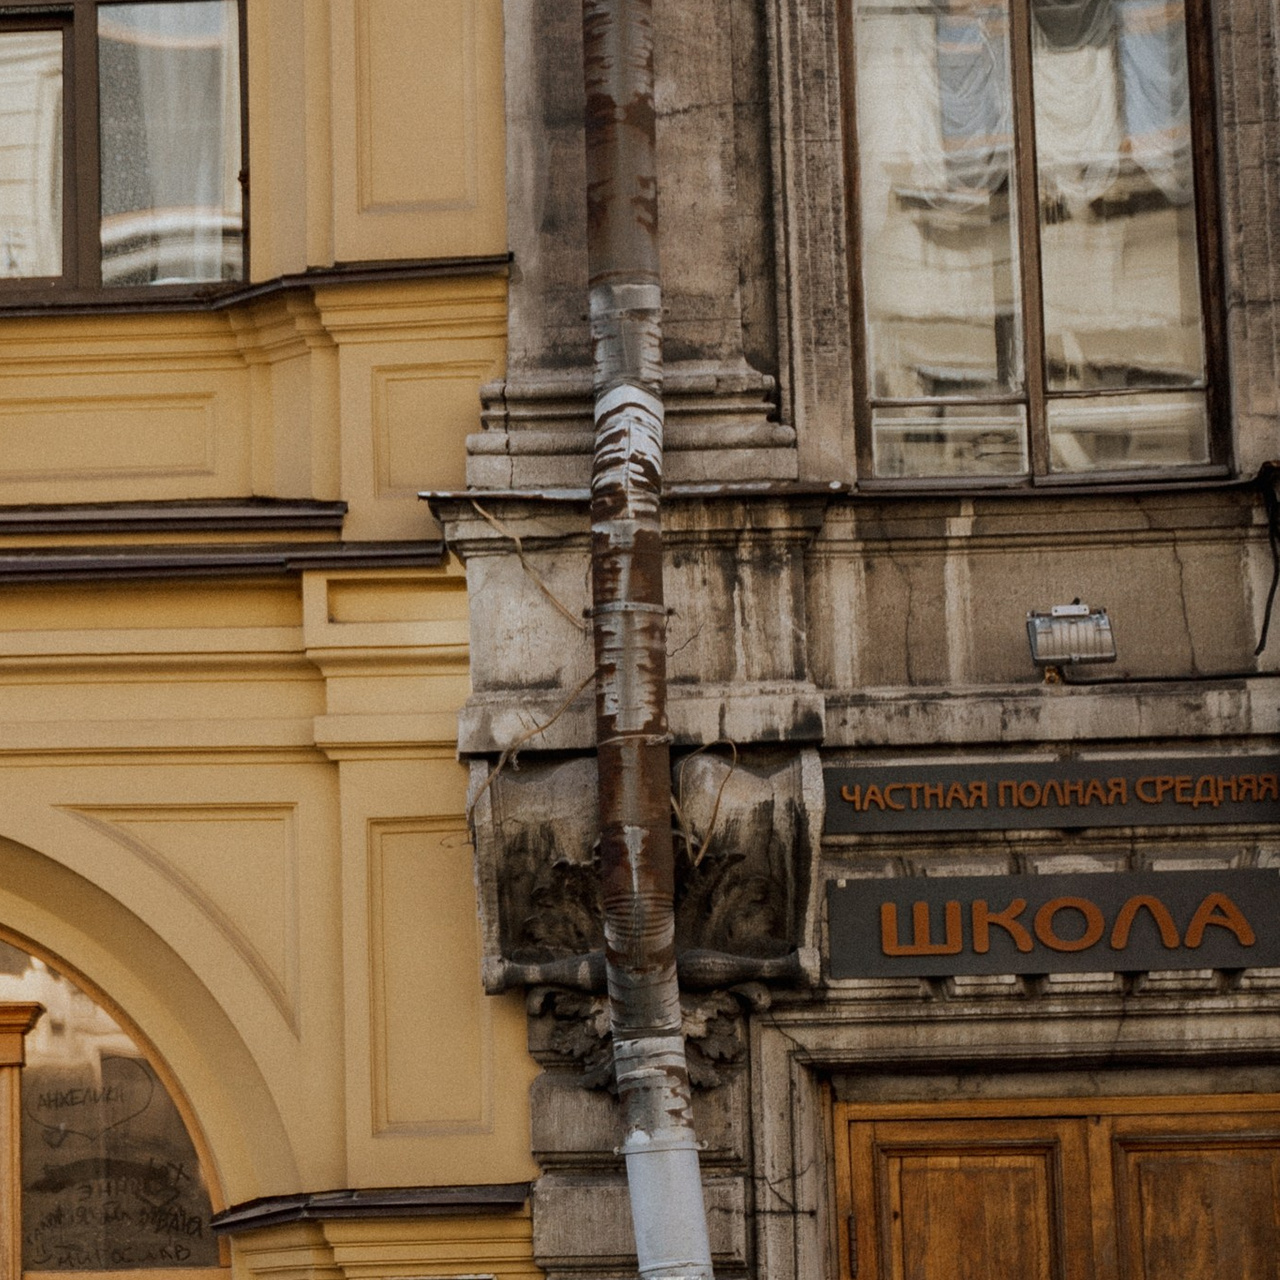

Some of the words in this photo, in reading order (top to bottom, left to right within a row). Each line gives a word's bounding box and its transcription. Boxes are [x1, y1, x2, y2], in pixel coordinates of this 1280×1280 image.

[840, 781, 988, 811] ЧАСТНАЯ
[998, 776, 1128, 808] ПОЛНАЯ
[1134, 773, 1279, 808] СРЕДНЯЯ
[880, 892, 1257, 957] ШКОЛА
